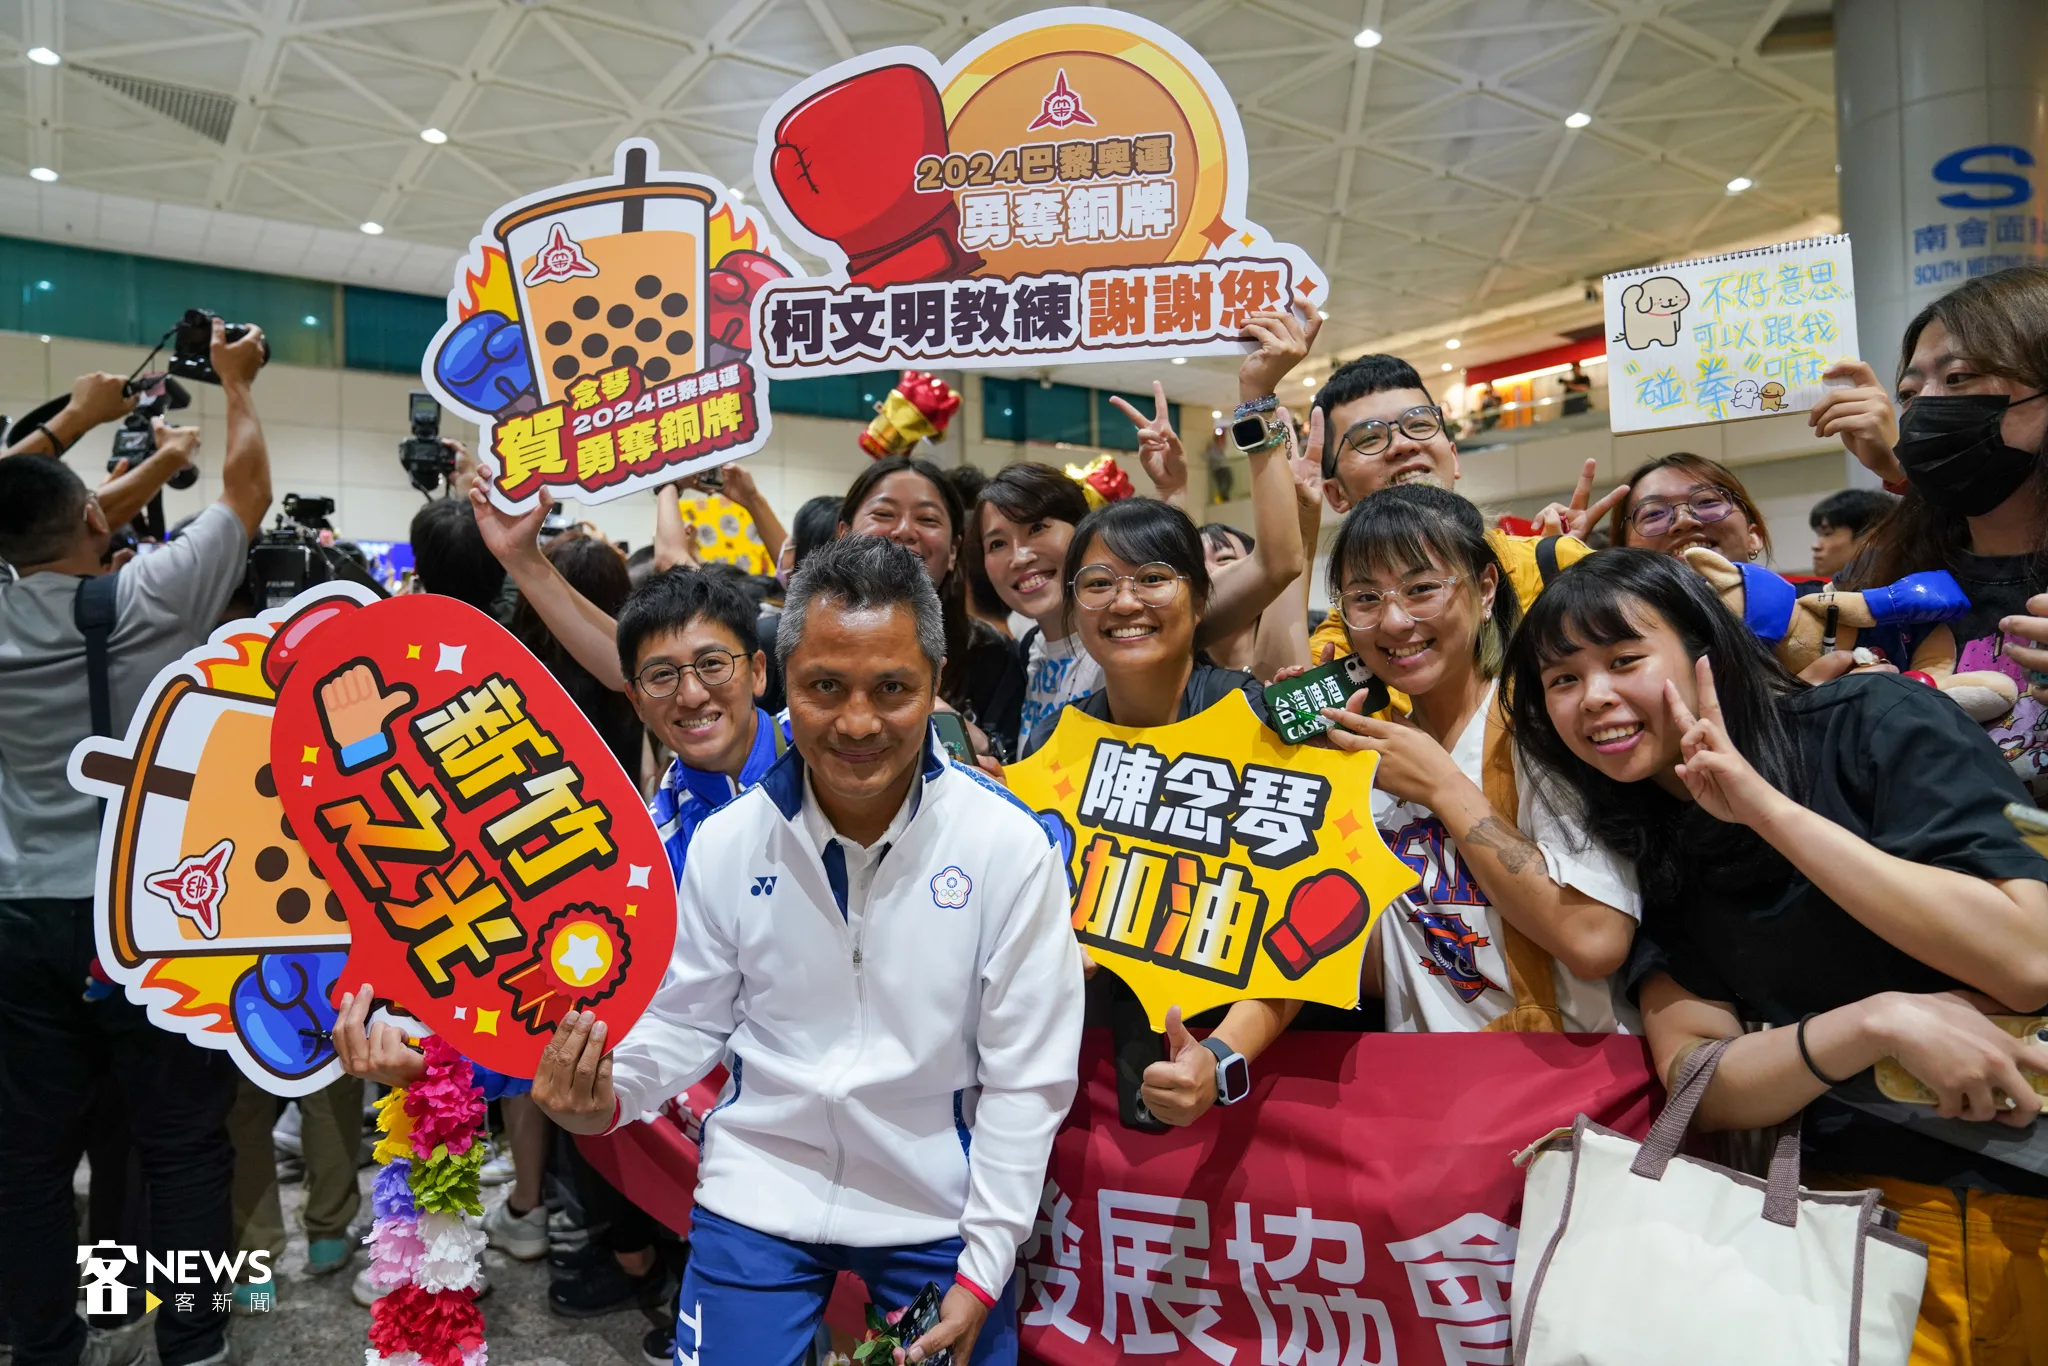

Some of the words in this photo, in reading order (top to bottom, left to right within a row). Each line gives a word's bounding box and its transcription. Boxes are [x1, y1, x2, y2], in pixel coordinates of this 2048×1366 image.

[918, 134, 1173, 191] 2024巴黎奧運
[1932, 144, 2036, 210] S
[962, 182, 1174, 248] 勇奪銅牌
[769, 282, 1075, 357] 柯文明教練
[1088, 269, 1288, 339] 謝謝您
[1914, 260, 1962, 286] SOUTH
[1692, 312, 1841, 354] 可以跟我
[570, 367, 631, 412] 念琴
[572, 364, 742, 436] 2024巴黎奧運
[497, 406, 569, 491] 賀
[576, 392, 744, 481] 勇奪銅牌
[414, 677, 616, 892] 新竹
[1080, 742, 1322, 858] 陳念琴
[320, 768, 525, 987] 之光
[1071, 838, 1261, 976] 加油
[1015, 1177, 1517, 1366] 發展協會
